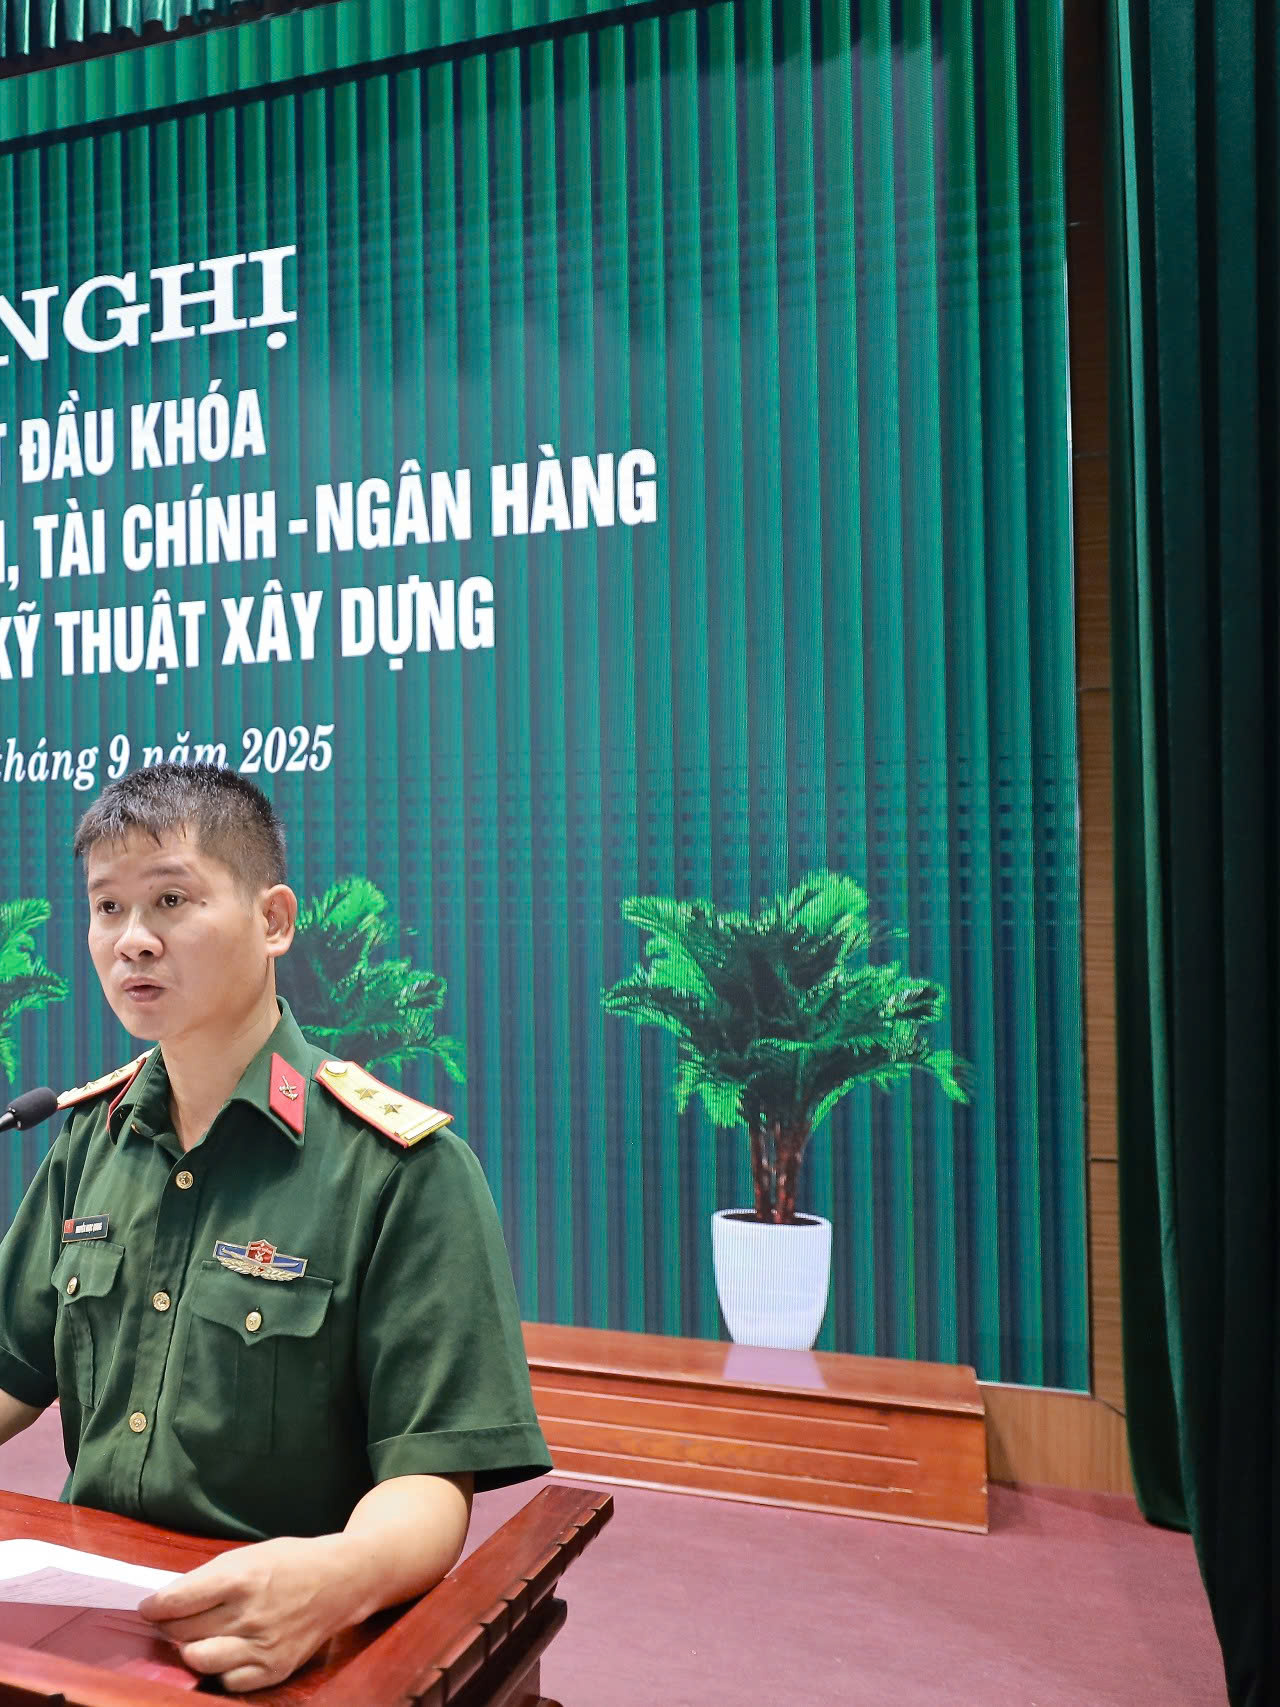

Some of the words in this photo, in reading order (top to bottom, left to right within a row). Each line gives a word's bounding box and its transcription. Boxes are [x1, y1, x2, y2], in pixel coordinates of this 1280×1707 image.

[19, 389, 114, 484] ĐẦU
[131, 378, 267, 471] KHÓA
[33, 497, 106, 579] TÀI
[122, 483, 277, 572] CHÍNH
[491, 443, 658, 538] HÀNG
[54, 588, 206, 685] THUẬT
[220, 579, 324, 666] XÂY
[340, 574, 495, 671] DỰNG
[107, 734, 130, 780] 9
[238, 723, 336, 774] 2025
